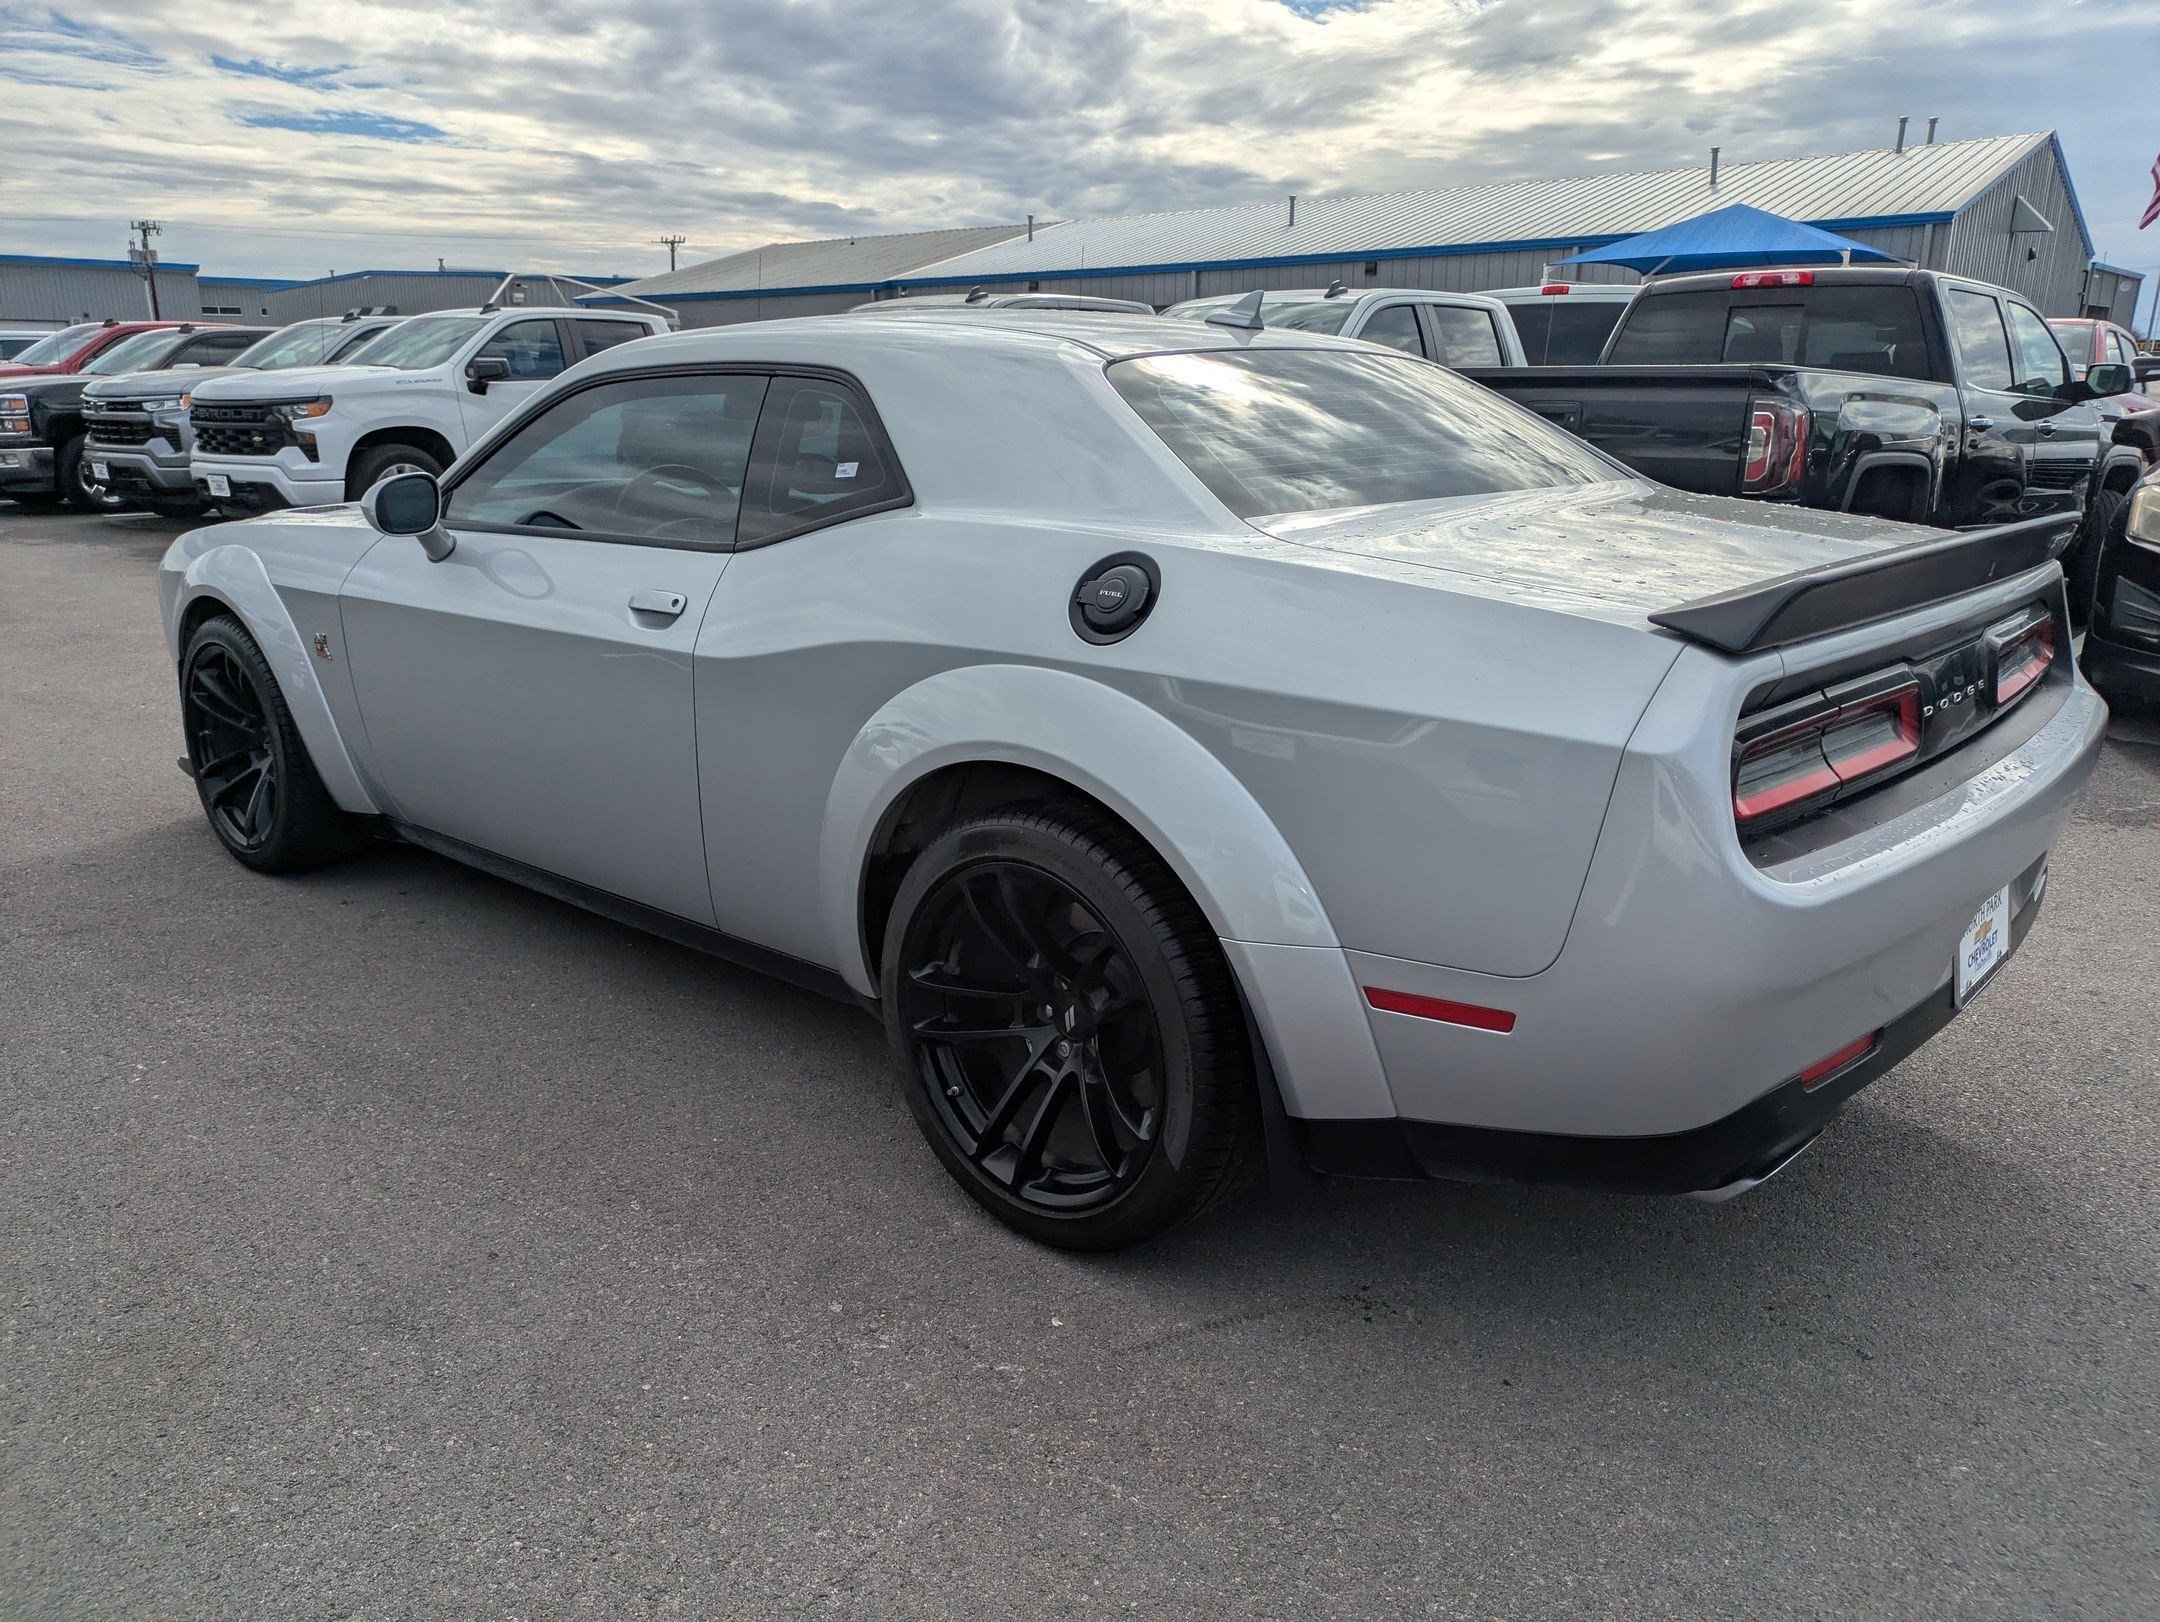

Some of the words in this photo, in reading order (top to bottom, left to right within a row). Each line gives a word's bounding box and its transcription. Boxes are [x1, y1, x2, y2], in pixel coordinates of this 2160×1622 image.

[1099, 589, 1123, 598] FUEL
[1923, 679, 1985, 718] DODGE
[1968, 929, 1999, 968] CHEVROLET
